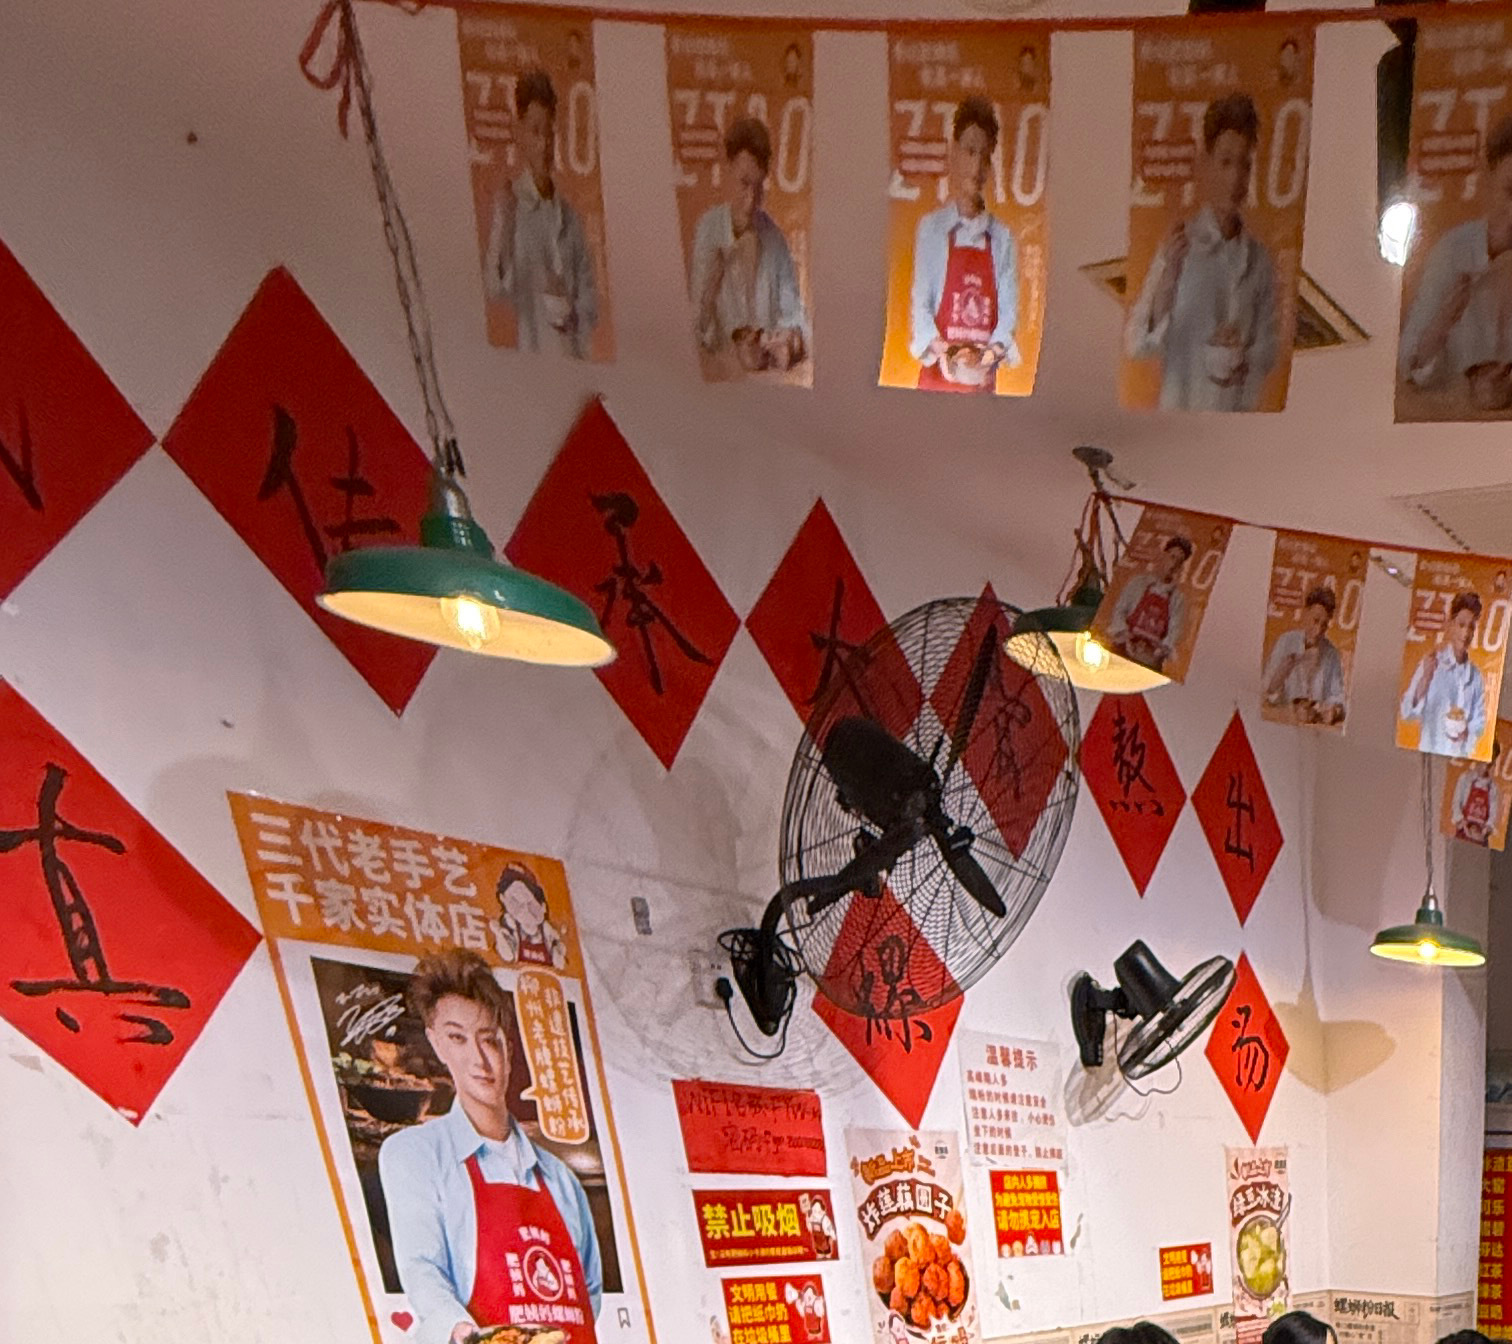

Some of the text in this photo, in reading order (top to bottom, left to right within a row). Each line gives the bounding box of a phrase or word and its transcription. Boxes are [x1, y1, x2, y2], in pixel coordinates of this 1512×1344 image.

[1225, 770, 1256, 873] 出
[250, 812, 478, 898] 三代老手艺
[266, 872, 490, 951] 千家实体店
[986, 1044, 1038, 1072] 温馨提示
[702, 1203, 801, 1240] 禁止吸烟
[730, 1283, 778, 1302] 文明用餐
[728, 1304, 789, 1324] 请把纸巾扔
